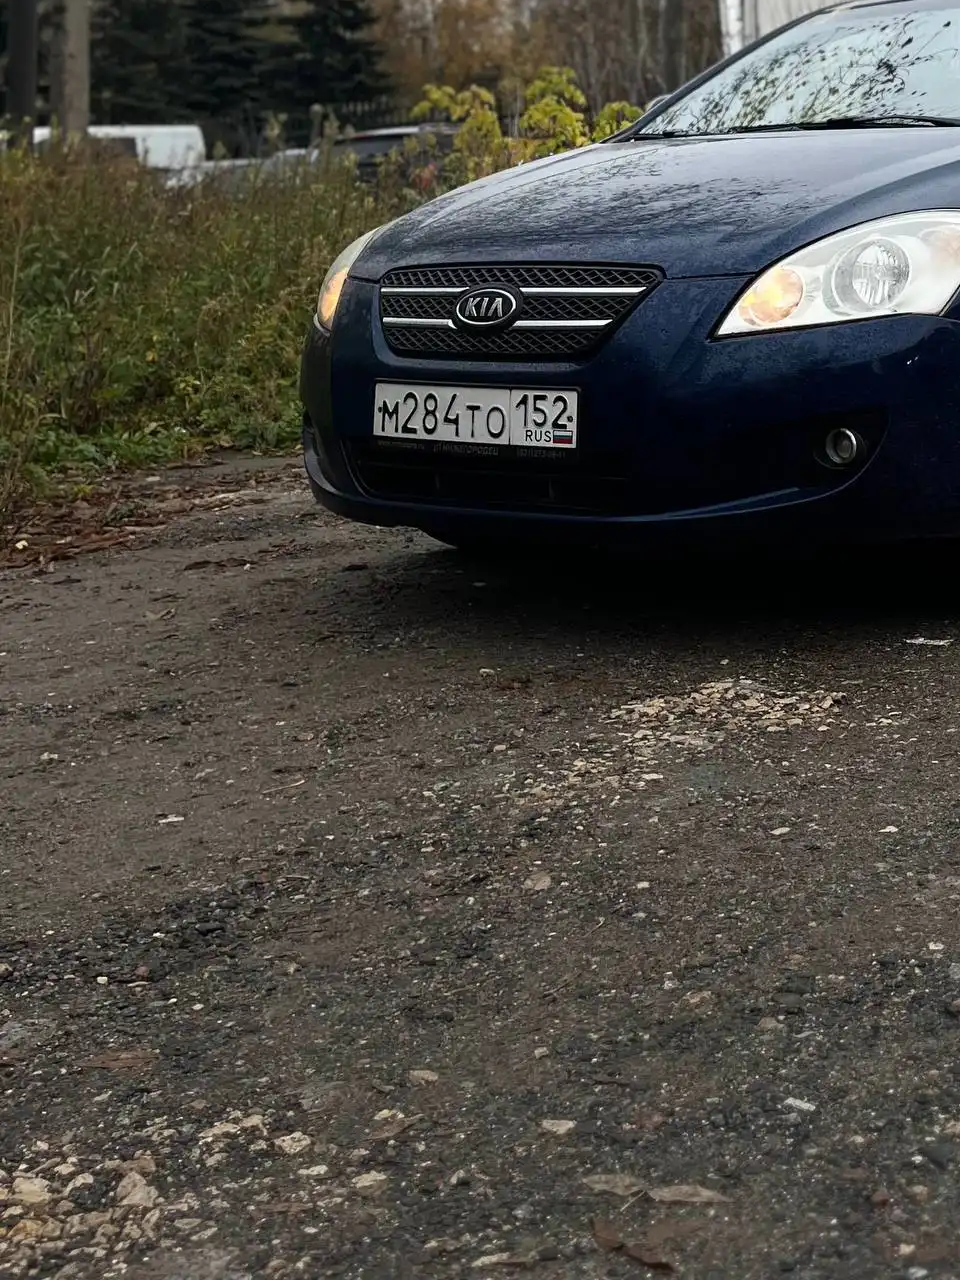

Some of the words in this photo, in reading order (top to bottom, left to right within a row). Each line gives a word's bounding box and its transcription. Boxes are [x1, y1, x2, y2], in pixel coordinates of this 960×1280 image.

[465, 297, 503, 317] KIA
[516, 393, 568, 429] 152
[525, 430, 552, 443] RUS
